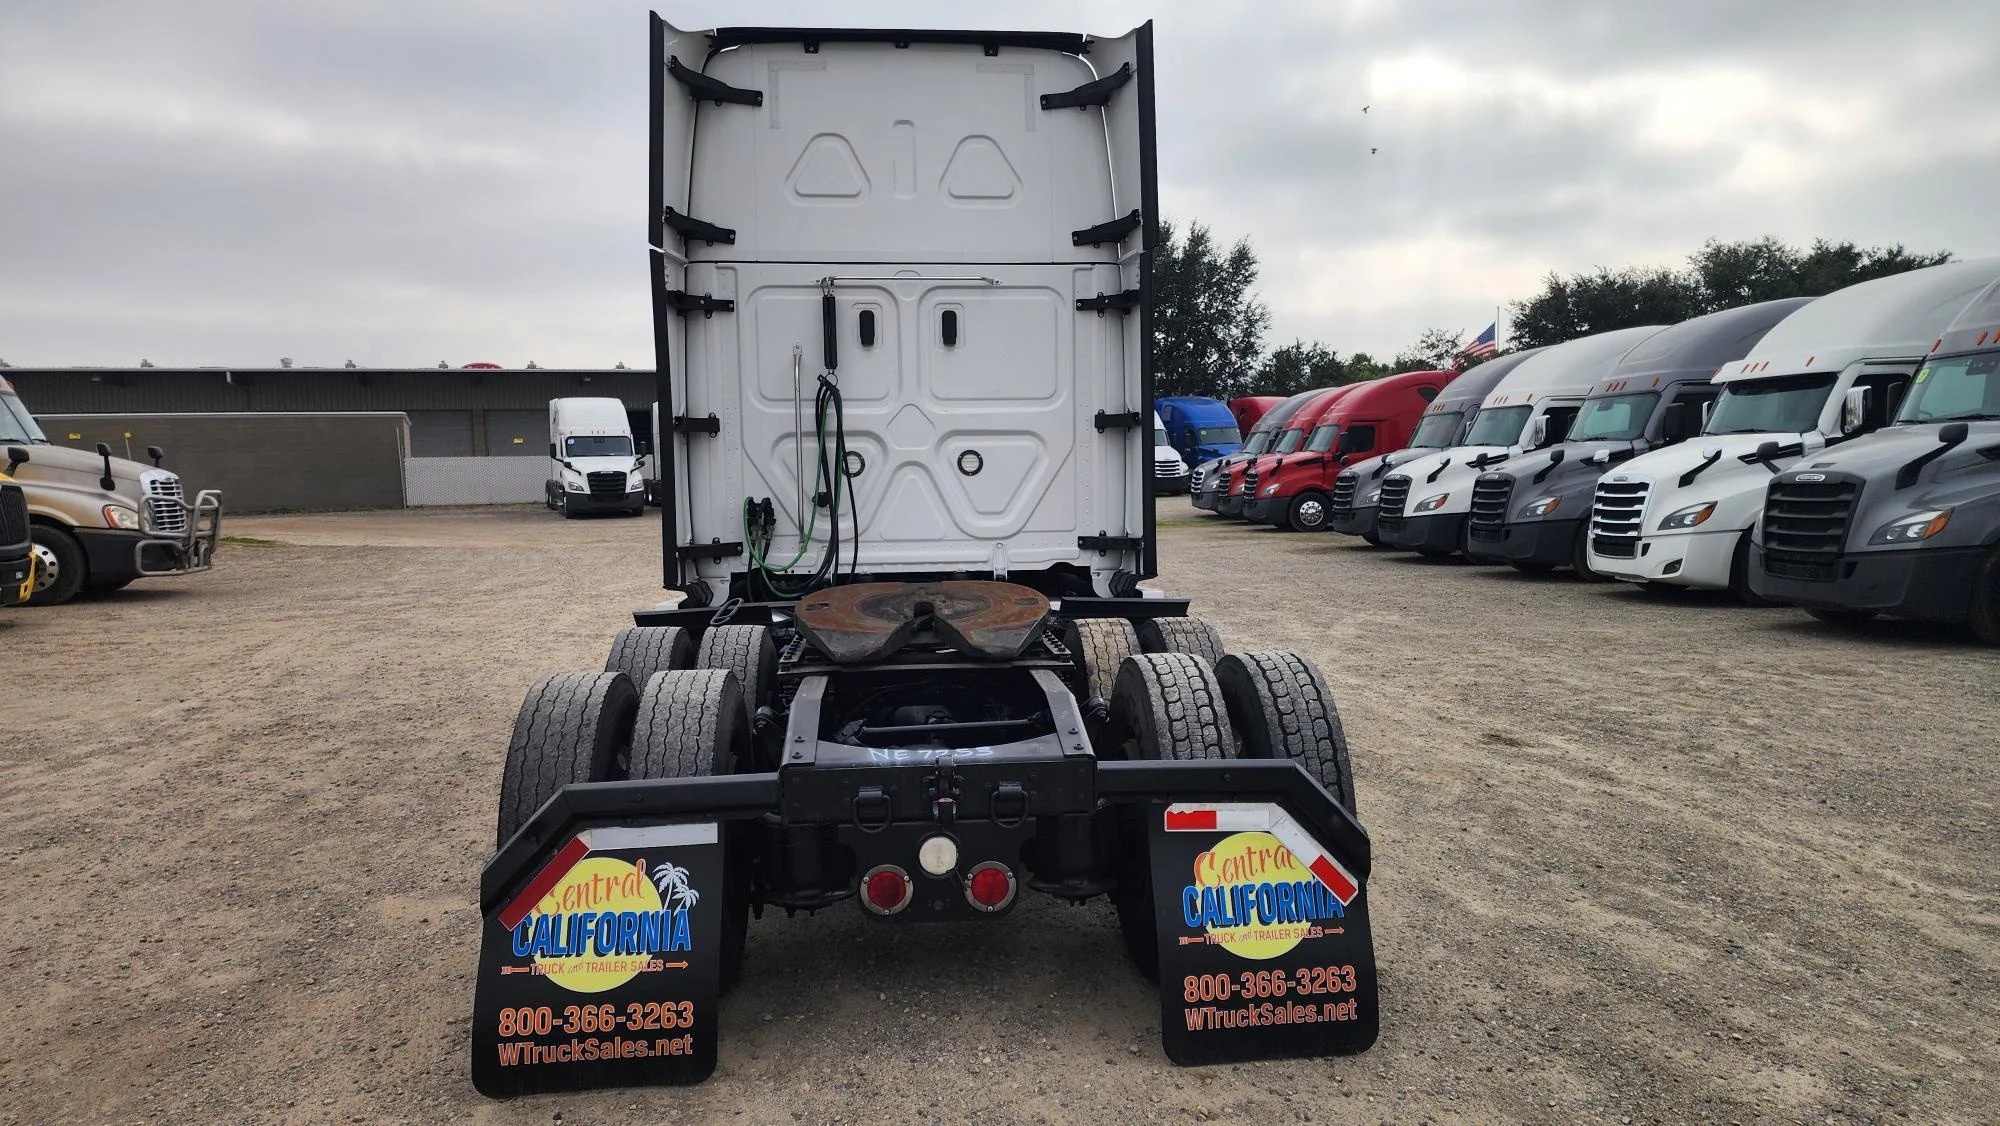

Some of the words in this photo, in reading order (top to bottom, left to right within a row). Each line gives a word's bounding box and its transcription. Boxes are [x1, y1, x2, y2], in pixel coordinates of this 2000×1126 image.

[1182, 879, 1345, 927] CALIFORNIA
[512, 908, 692, 957] CALIFORNIA
[1204, 932, 1236, 945] TRUCK
[1239, 928, 1253, 942] and
[1254, 928, 1293, 941] TRAILER
[1294, 925, 1323, 939] SALES
[529, 962, 565, 976] TRUCK
[568, 960, 584, 973] and
[586, 960, 627, 973] TRAILER
[630, 959, 664, 973] SALES
[1184, 965, 1357, 1003] 800-366-3263
[498, 1000, 694, 1037] 800-366-3263
[1184, 998, 1358, 1031] WTruckSales.net
[498, 1033, 693, 1067] WTruckSales.net
